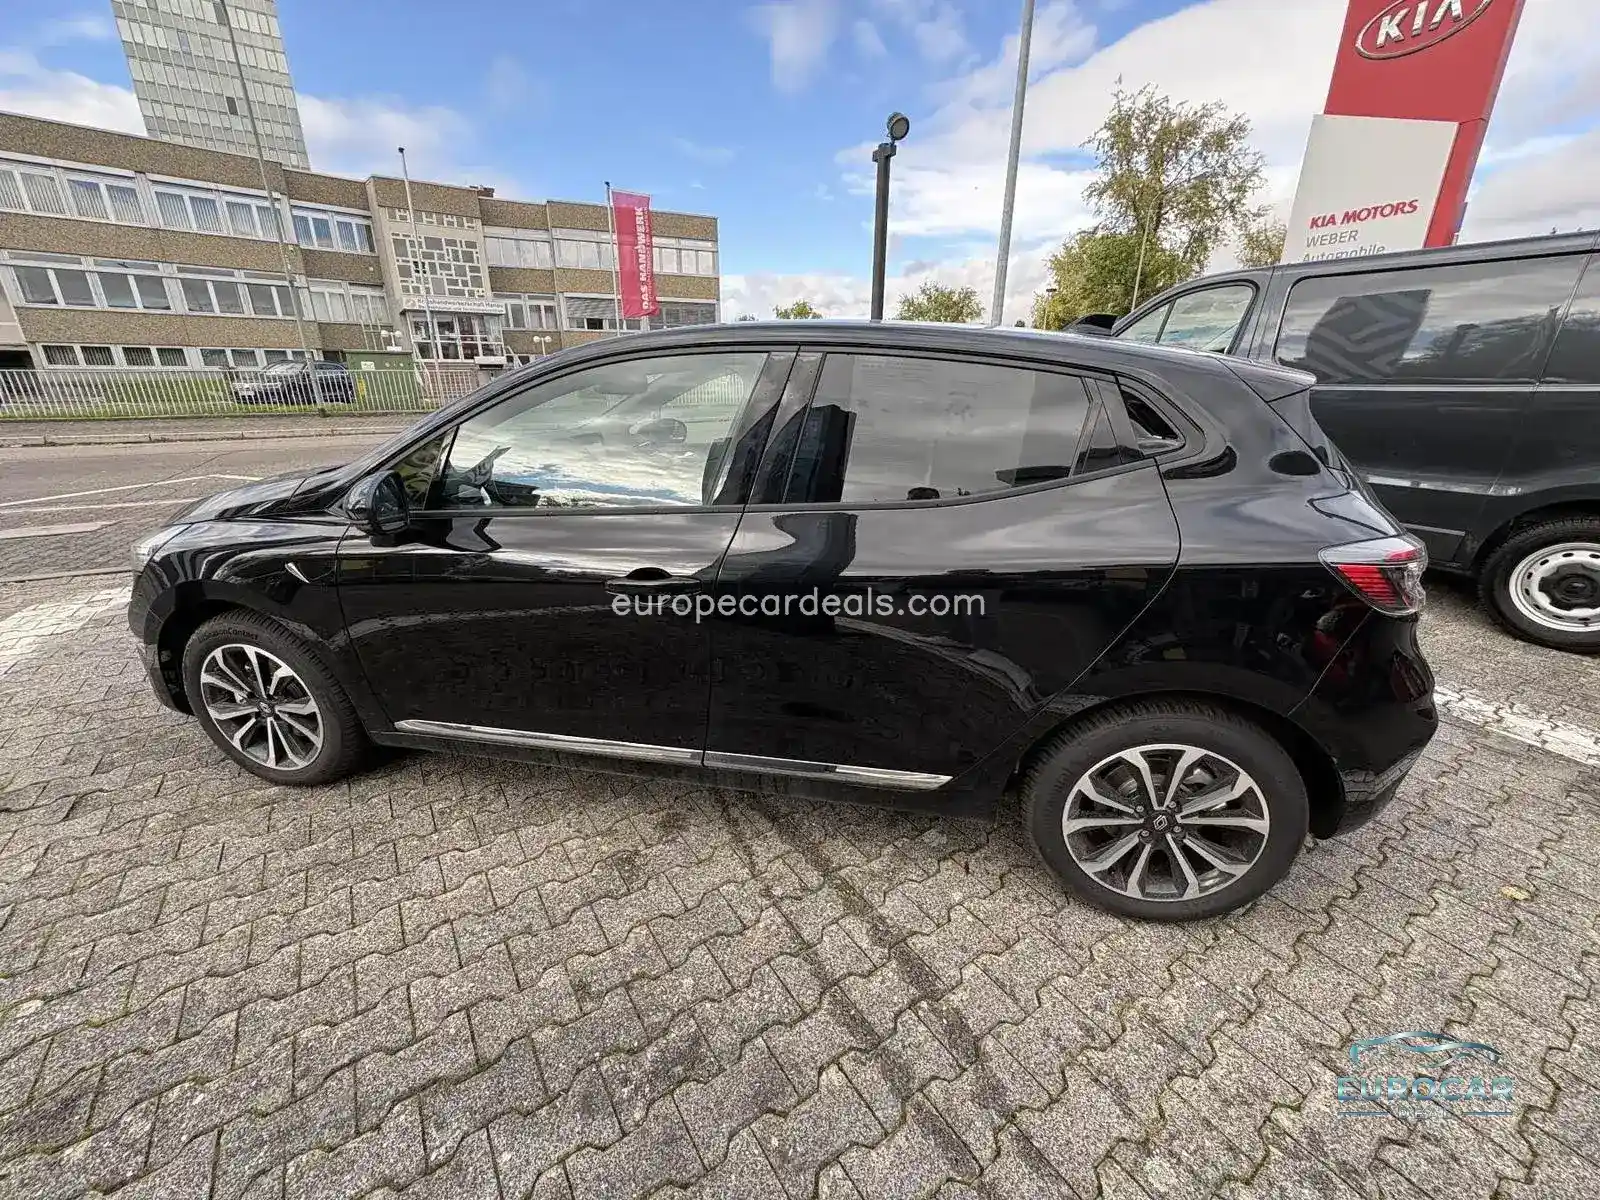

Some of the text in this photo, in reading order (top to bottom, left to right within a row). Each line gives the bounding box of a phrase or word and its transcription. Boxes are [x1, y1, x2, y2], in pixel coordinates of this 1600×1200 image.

[1376, 0, 1464, 48] KIA
[1309, 199, 1419, 230] KIA MOTORS
[1302, 244, 1385, 262] Automobile
[1306, 229, 1359, 248] WEBER
[634, 206, 649, 310] DAS HANDWERK
